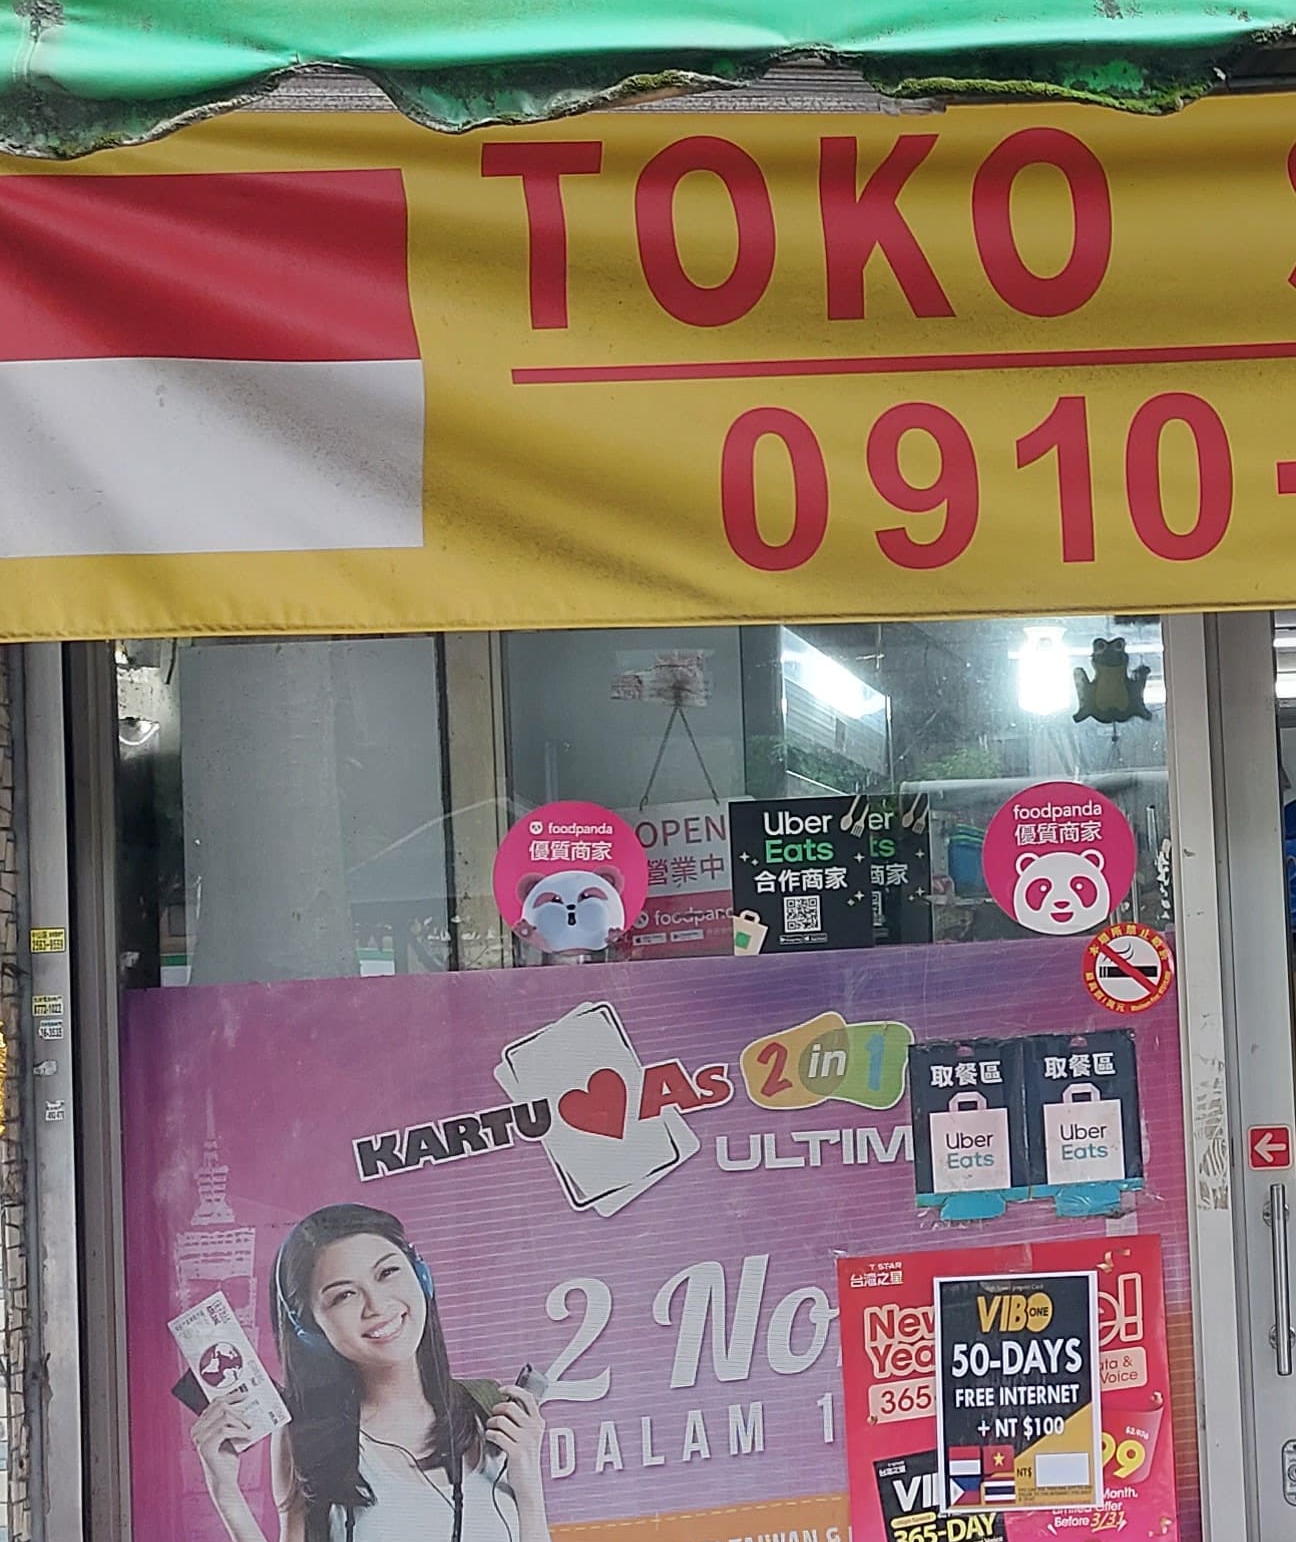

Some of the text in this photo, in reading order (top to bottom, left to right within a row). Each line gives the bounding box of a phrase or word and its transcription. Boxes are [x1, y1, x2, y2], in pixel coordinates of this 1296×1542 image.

[480, 128, 1112, 329] TOKO
[868, 811, 895, 830] er
[1013, 800, 1102, 821] foodpanda
[548, 822, 613, 837] foodpanda
[636, 814, 727, 849] OPEN
[763, 811, 833, 835] Uber
[1015, 821, 1102, 846] 優質商家
[529, 840, 613, 861] 優質商家
[765, 838, 834, 863] Eats
[869, 836, 896, 858] ts
[647, 854, 725, 887] 營業中
[754, 867, 848, 893] 合作商家
[870, 863, 909, 886] 商家
[930, 1061, 1004, 1088] 取餐區
[1044, 1052, 1117, 1080] 取餐區
[353, 1033, 888, 1181] KARTU As 2 in 1
[946, 1132, 994, 1150] Uber
[1060, 1124, 1108, 1141] Uber
[716, 1125, 914, 1172] ULTIM
[1061, 1143, 1109, 1161] Eats
[947, 1152, 995, 1170] Eats
[877, 1261, 902, 1271] STAR
[850, 1270, 904, 1288] 台灣之星
[977, 1292, 1053, 1333] VIBO
[1028, 1306, 1049, 1317] ONE
[539, 1254, 840, 1407] 2 No
[870, 1343, 935, 1373] Yea
[952, 1338, 1082, 1377] 50-DAYS
[955, 1383, 1080, 1407] FREE INTERNET
[550, 1401, 765, 1479] DALAM
[977, 1416, 1065, 1440] + NT $100
[1016, 1467, 1032, 1478] NT$
[1054, 1515, 1090, 1528] Before
